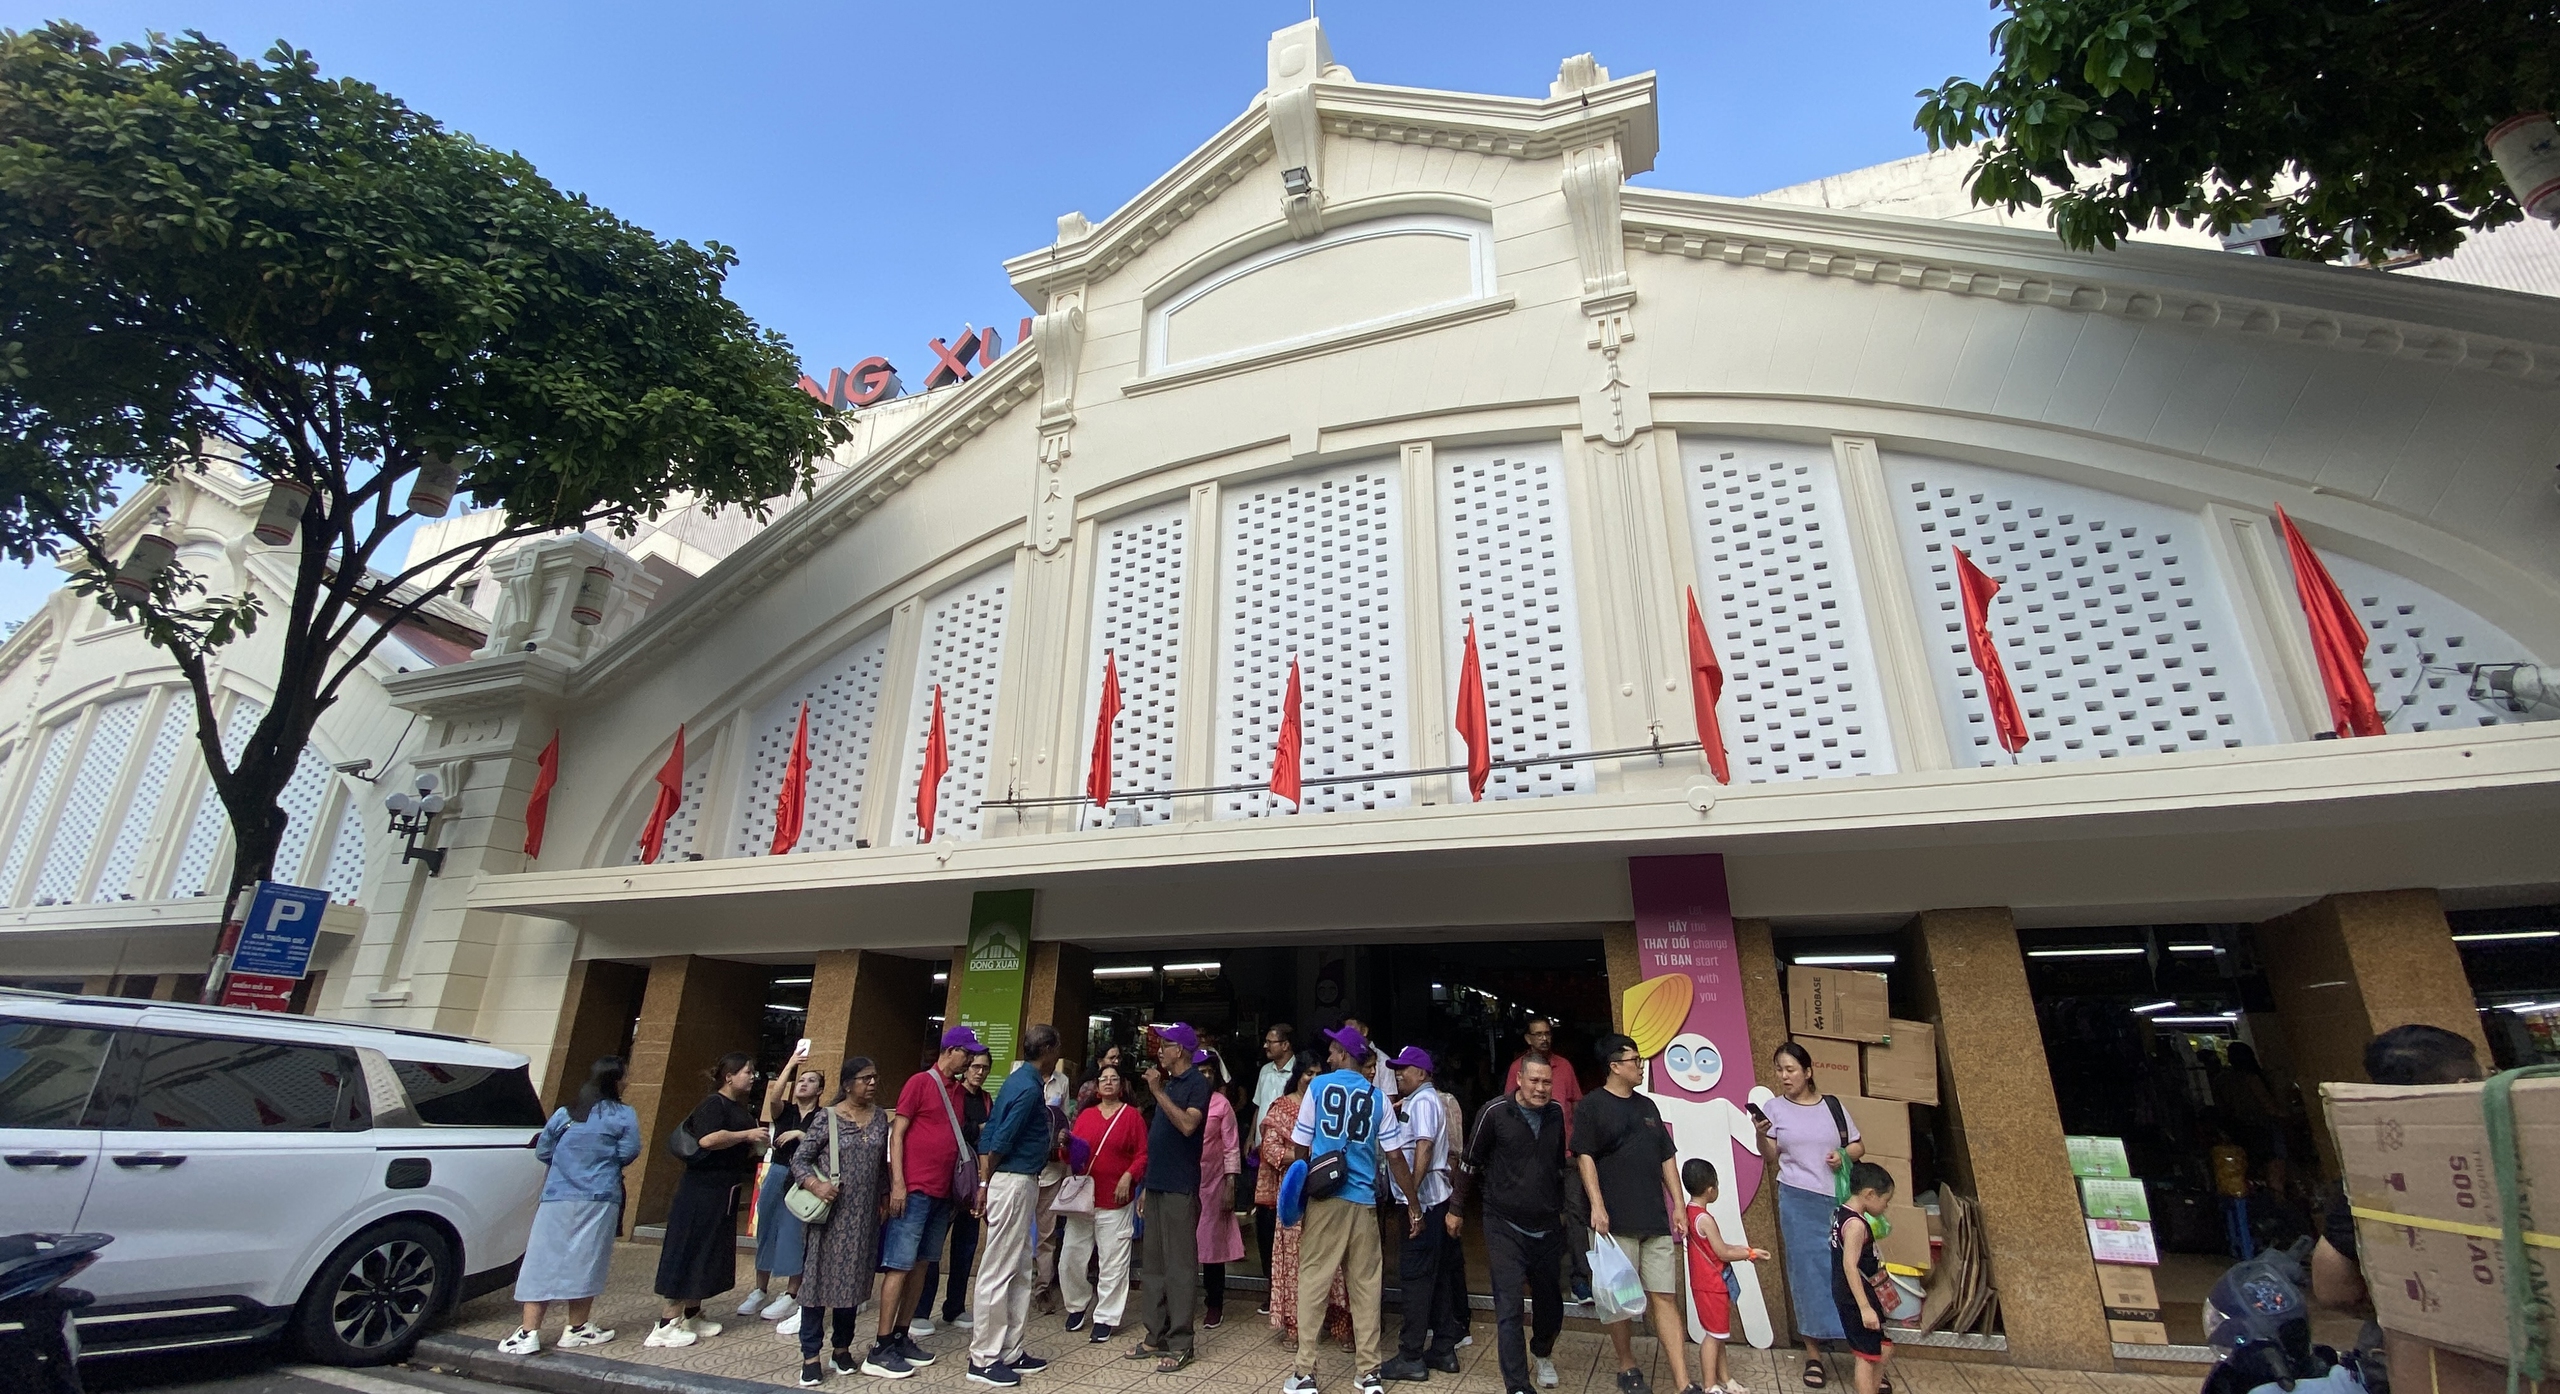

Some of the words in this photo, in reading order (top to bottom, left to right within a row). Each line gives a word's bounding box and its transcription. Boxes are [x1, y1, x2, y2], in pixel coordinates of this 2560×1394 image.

[797, 356, 900, 408] NG
[923, 317, 1032, 391] XU
[266, 898, 306, 932] P
[1668, 920, 1687, 932] HÃY
[1690, 922, 1707, 932] the
[1643, 938, 1668, 949] THAY
[1692, 939, 1728, 951] change
[1670, 954, 1693, 968] BẠN
[1695, 955, 1719, 967] start
[1697, 972, 1719, 984] with
[1699, 992, 1717, 1003] you
[1813, 976, 1822, 1015] MOBASE
[1320, 1083, 1375, 1145] 98
[2449, 1154, 2476, 1209] 500
